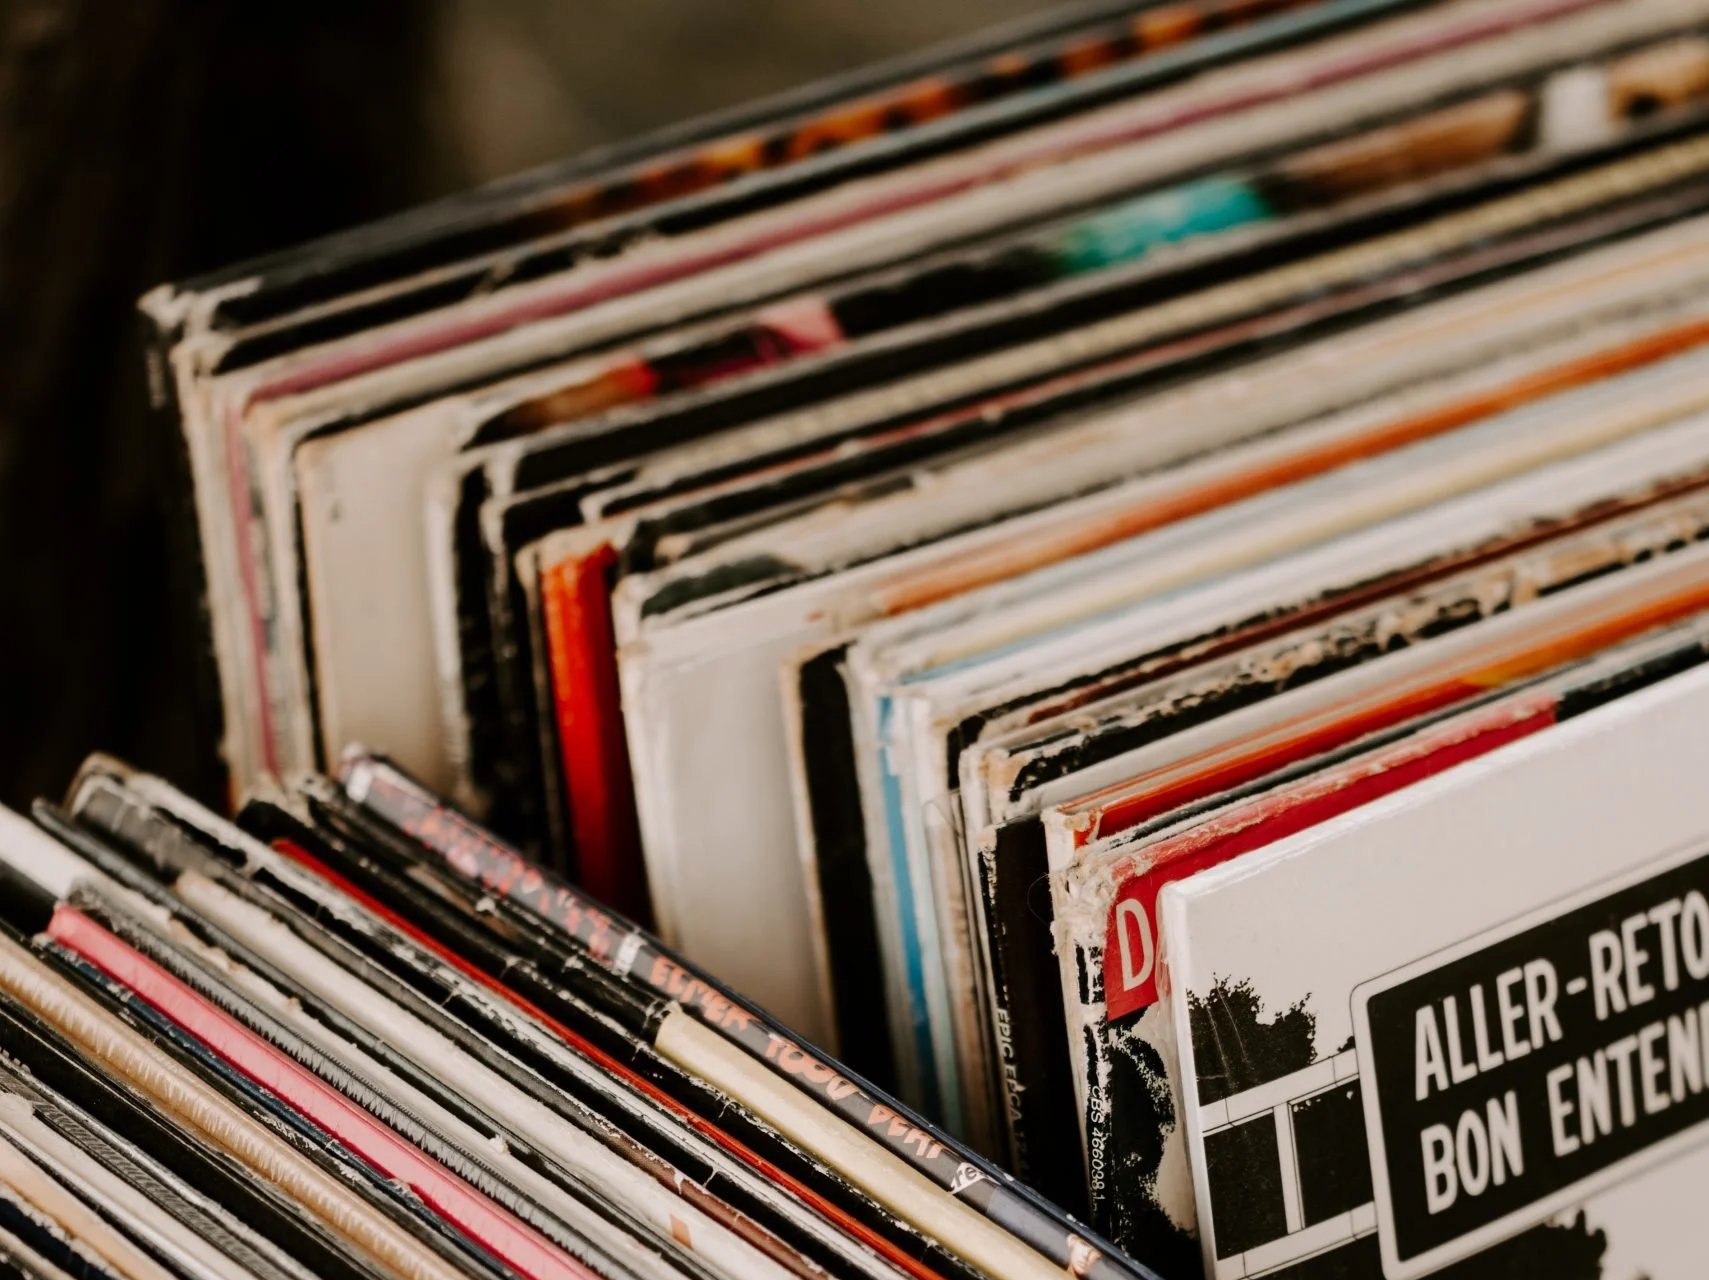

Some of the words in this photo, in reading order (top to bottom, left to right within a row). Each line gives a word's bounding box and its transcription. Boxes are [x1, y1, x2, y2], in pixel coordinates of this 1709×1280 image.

[997, 1008, 1015, 1058] EPIC
[1091, 1085, 1105, 1123] CBS
[1420, 1090, 1524, 1215] BON
[1547, 1001, 1709, 1157] ENTEN
